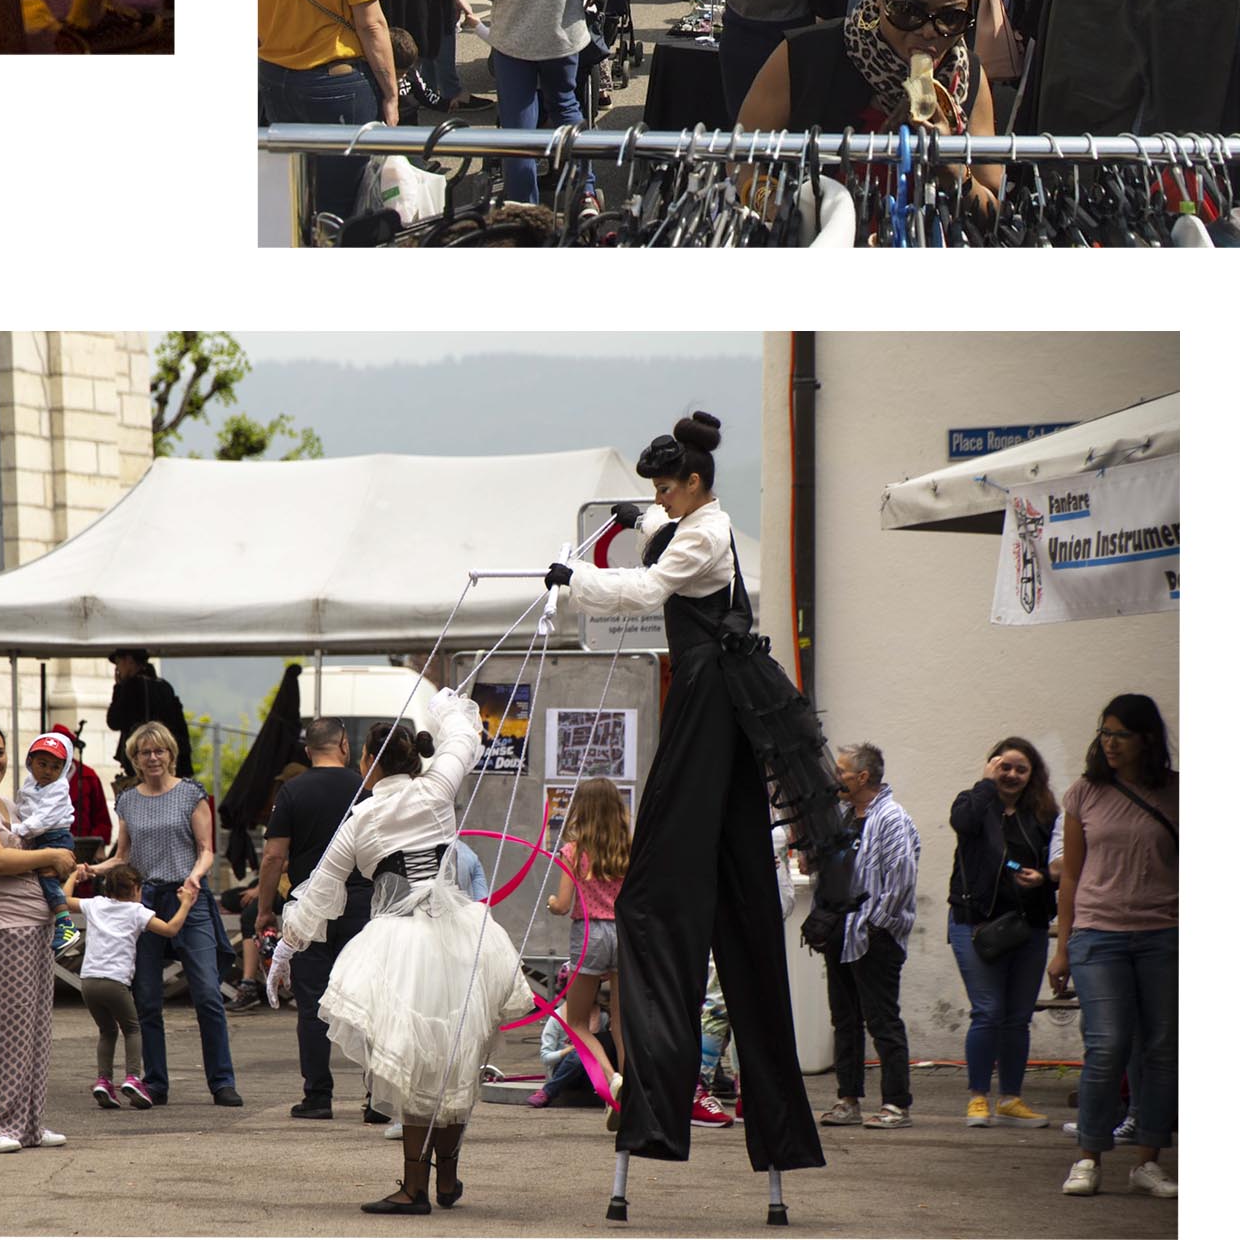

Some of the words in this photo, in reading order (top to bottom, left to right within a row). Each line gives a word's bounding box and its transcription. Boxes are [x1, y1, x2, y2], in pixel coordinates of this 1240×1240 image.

[952, 432, 983, 453] Place
[1049, 492, 1090, 515] Fanfare
[1048, 535, 1092, 564] Union
[1164, 570, 1180, 591] D
